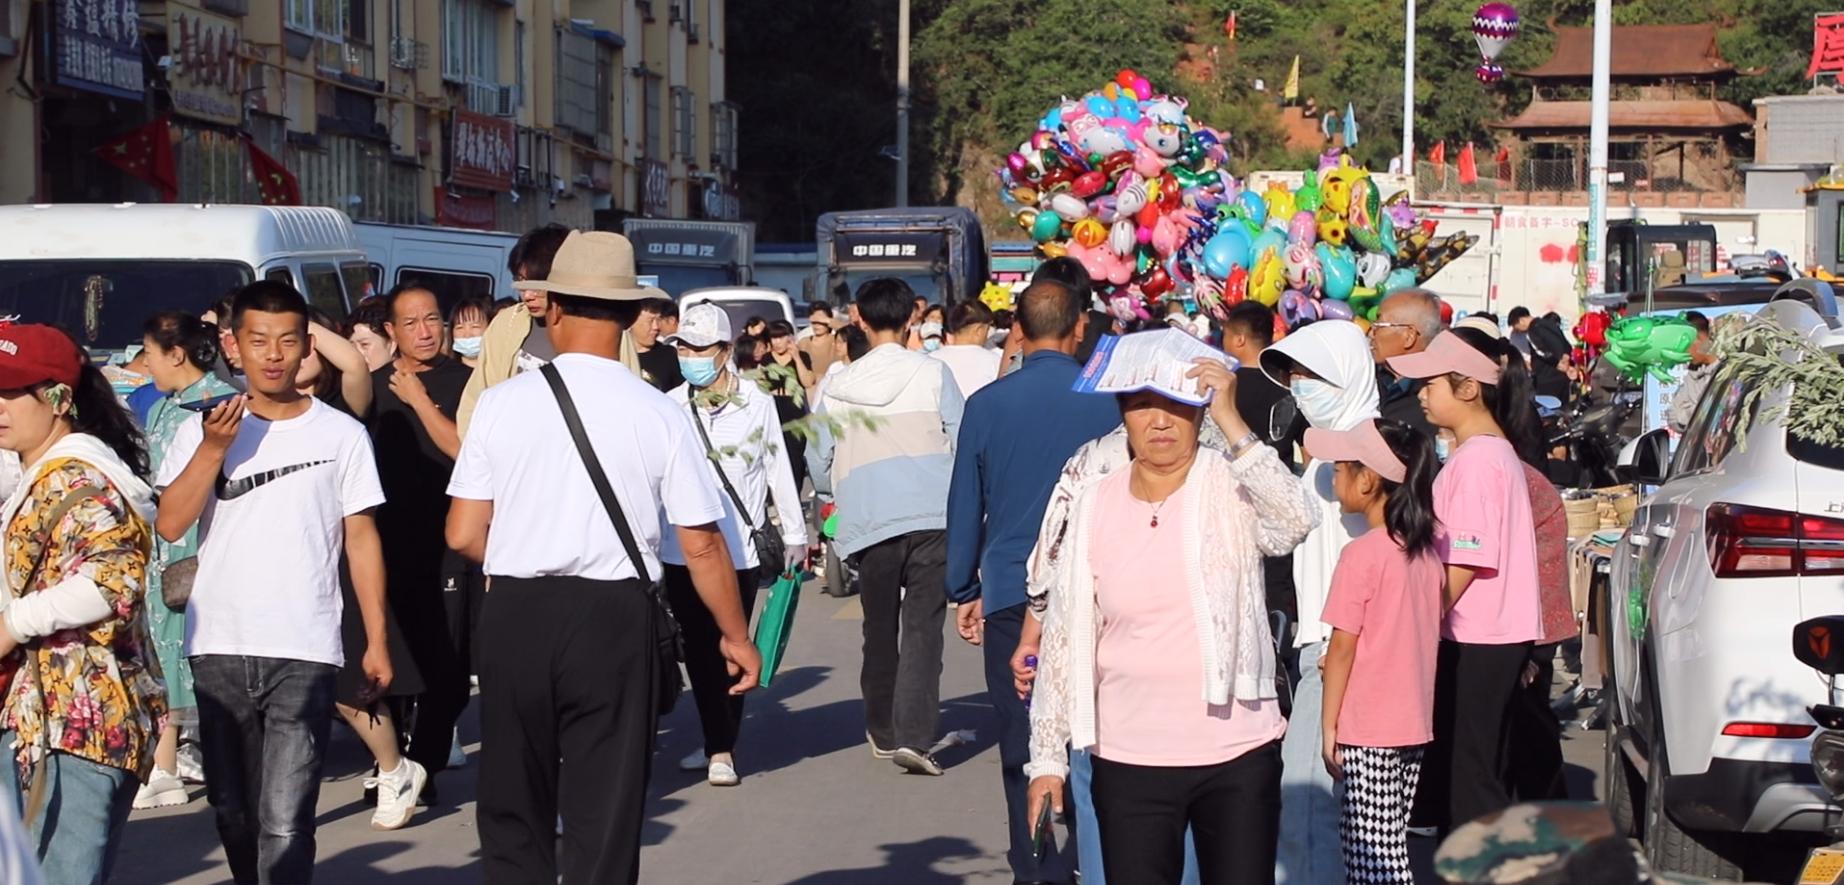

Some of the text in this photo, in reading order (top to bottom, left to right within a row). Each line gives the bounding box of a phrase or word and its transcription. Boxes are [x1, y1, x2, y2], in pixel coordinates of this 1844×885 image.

[648, 243, 715, 257] 中国重汽
[853, 244, 917, 256] 中国重汽
[1823, 500, 1844, 513] 上
